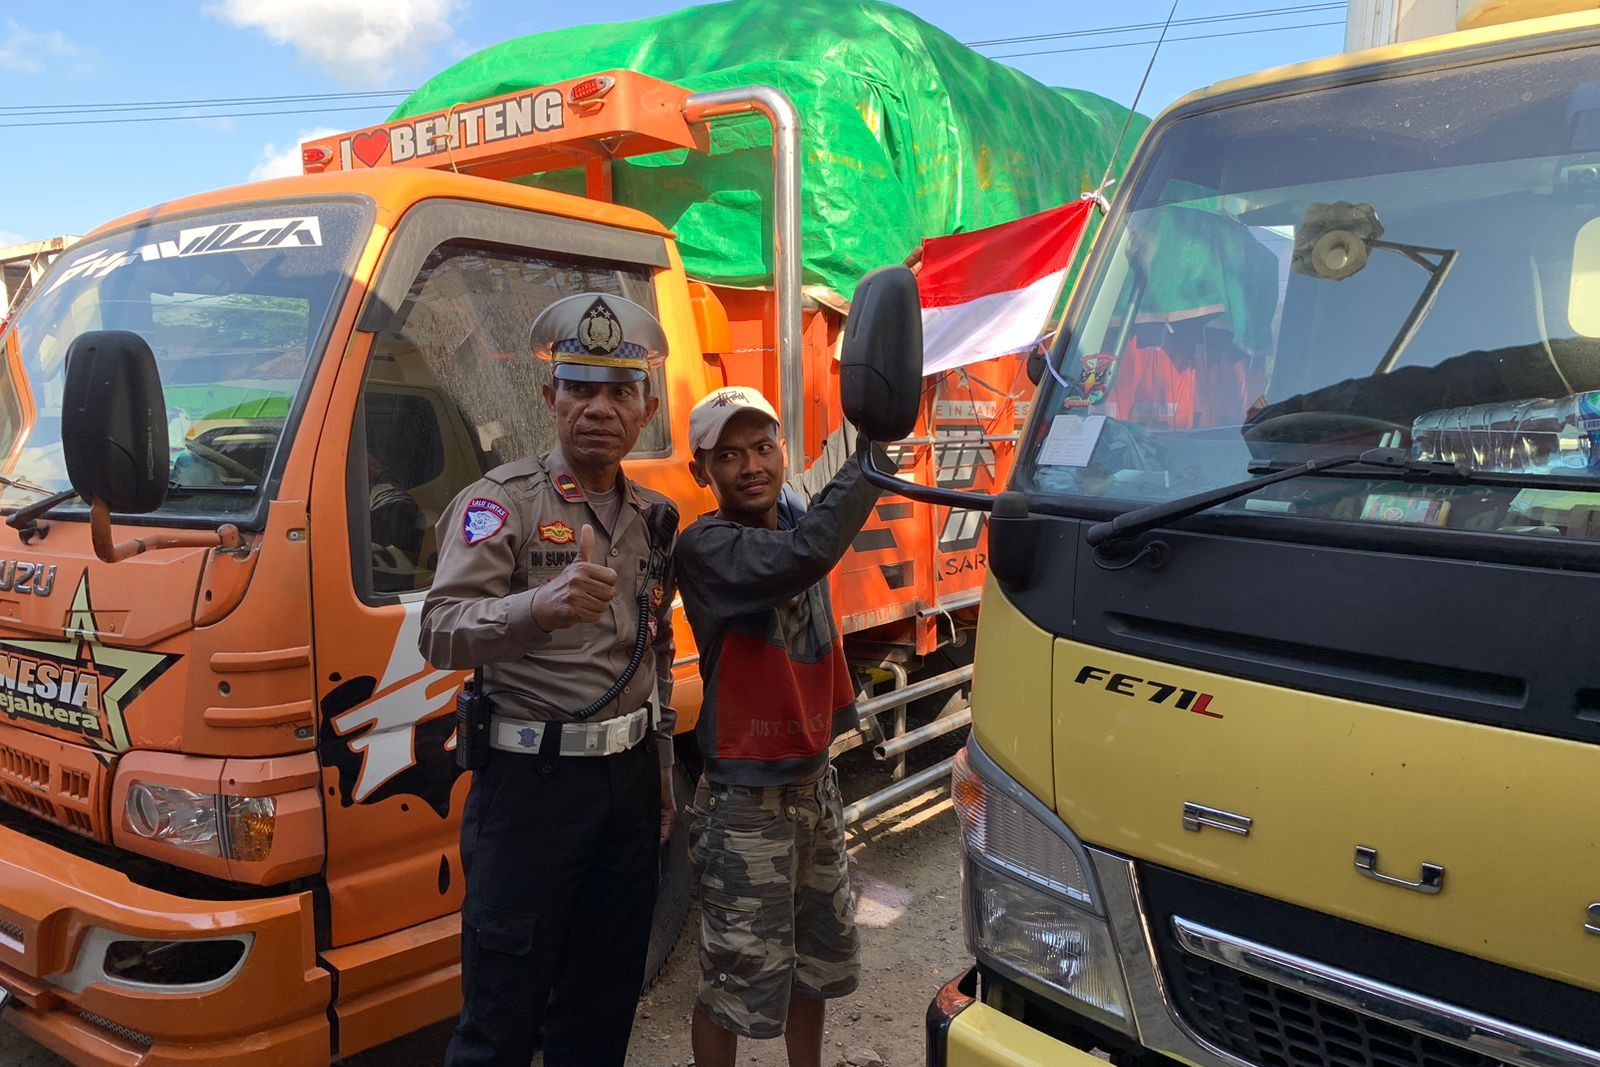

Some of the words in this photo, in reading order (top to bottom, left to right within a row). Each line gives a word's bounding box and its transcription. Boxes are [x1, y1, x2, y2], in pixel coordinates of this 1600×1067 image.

[340, 140, 354, 170] I
[389, 89, 565, 164] BENTENG
[486, 501, 506, 517] LINTAS
[1074, 665, 1224, 719] FE71L
